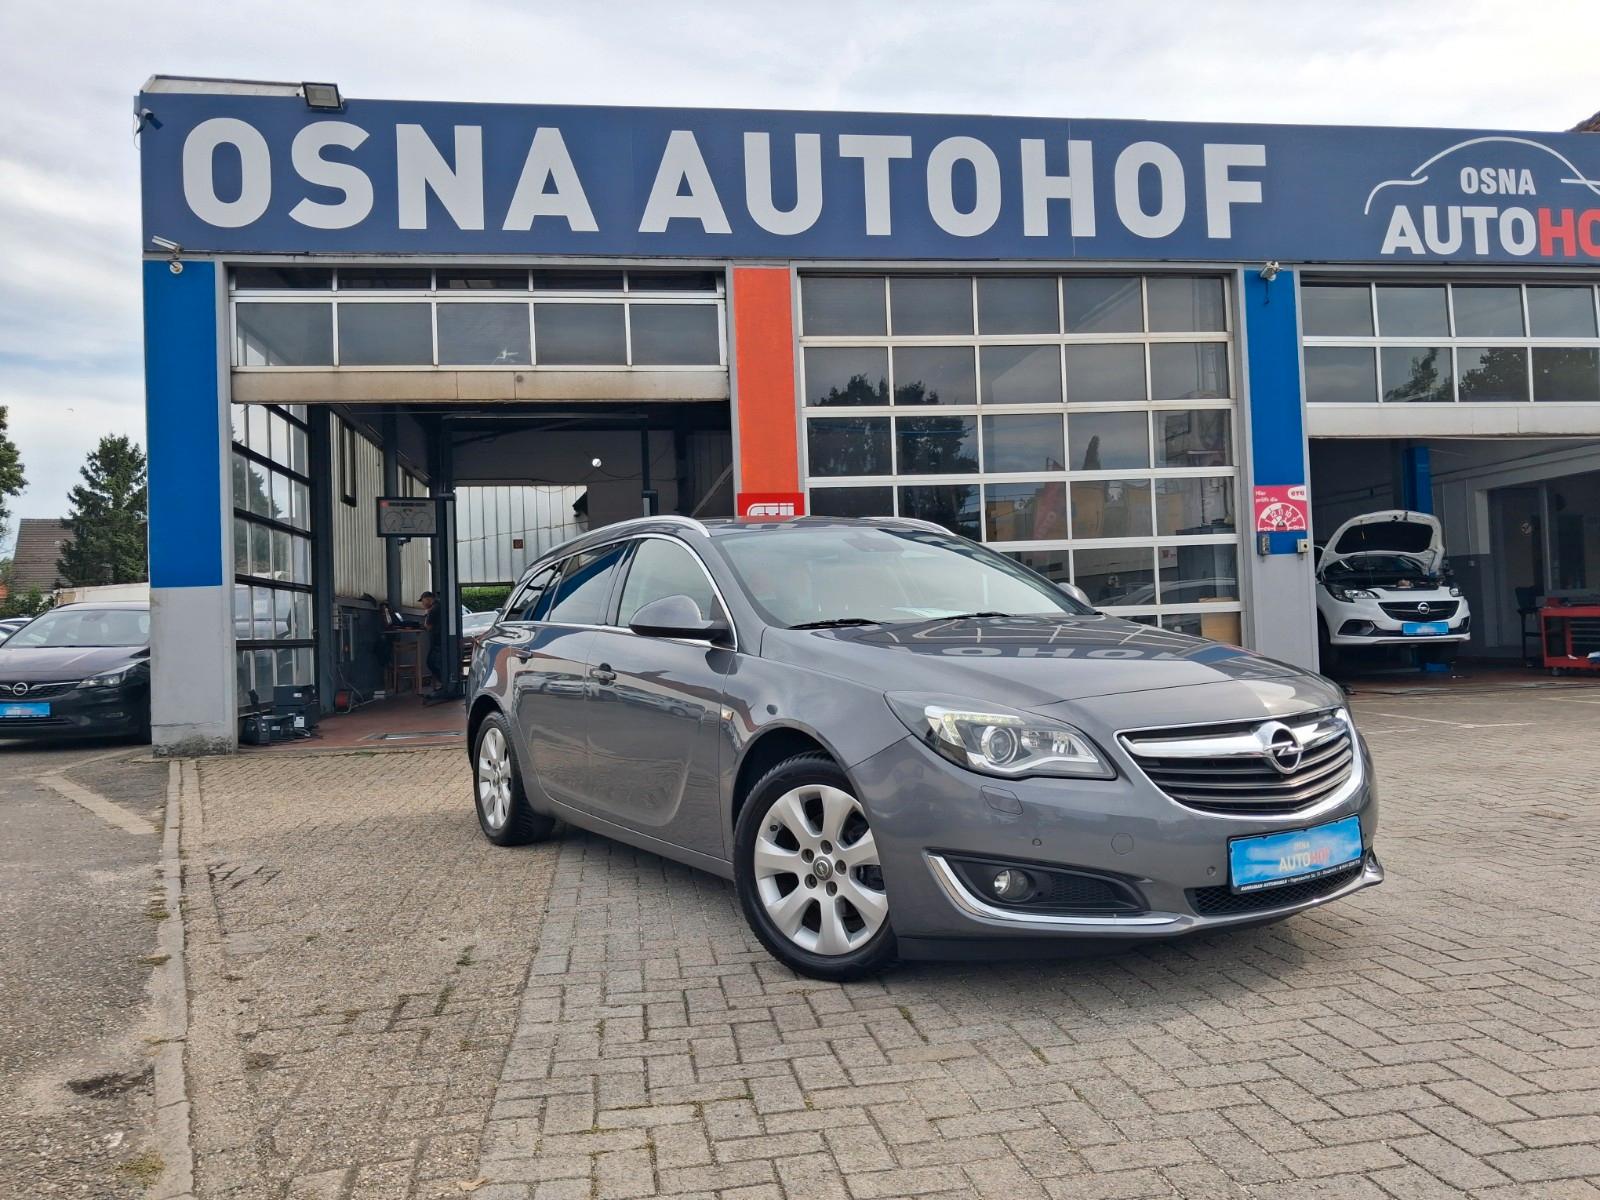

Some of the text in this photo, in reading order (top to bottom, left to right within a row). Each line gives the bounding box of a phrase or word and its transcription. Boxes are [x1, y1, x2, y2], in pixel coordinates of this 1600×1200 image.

[181, 116, 1269, 240] OSNA AUTOHOF
[1459, 166, 1537, 196] OSNA
